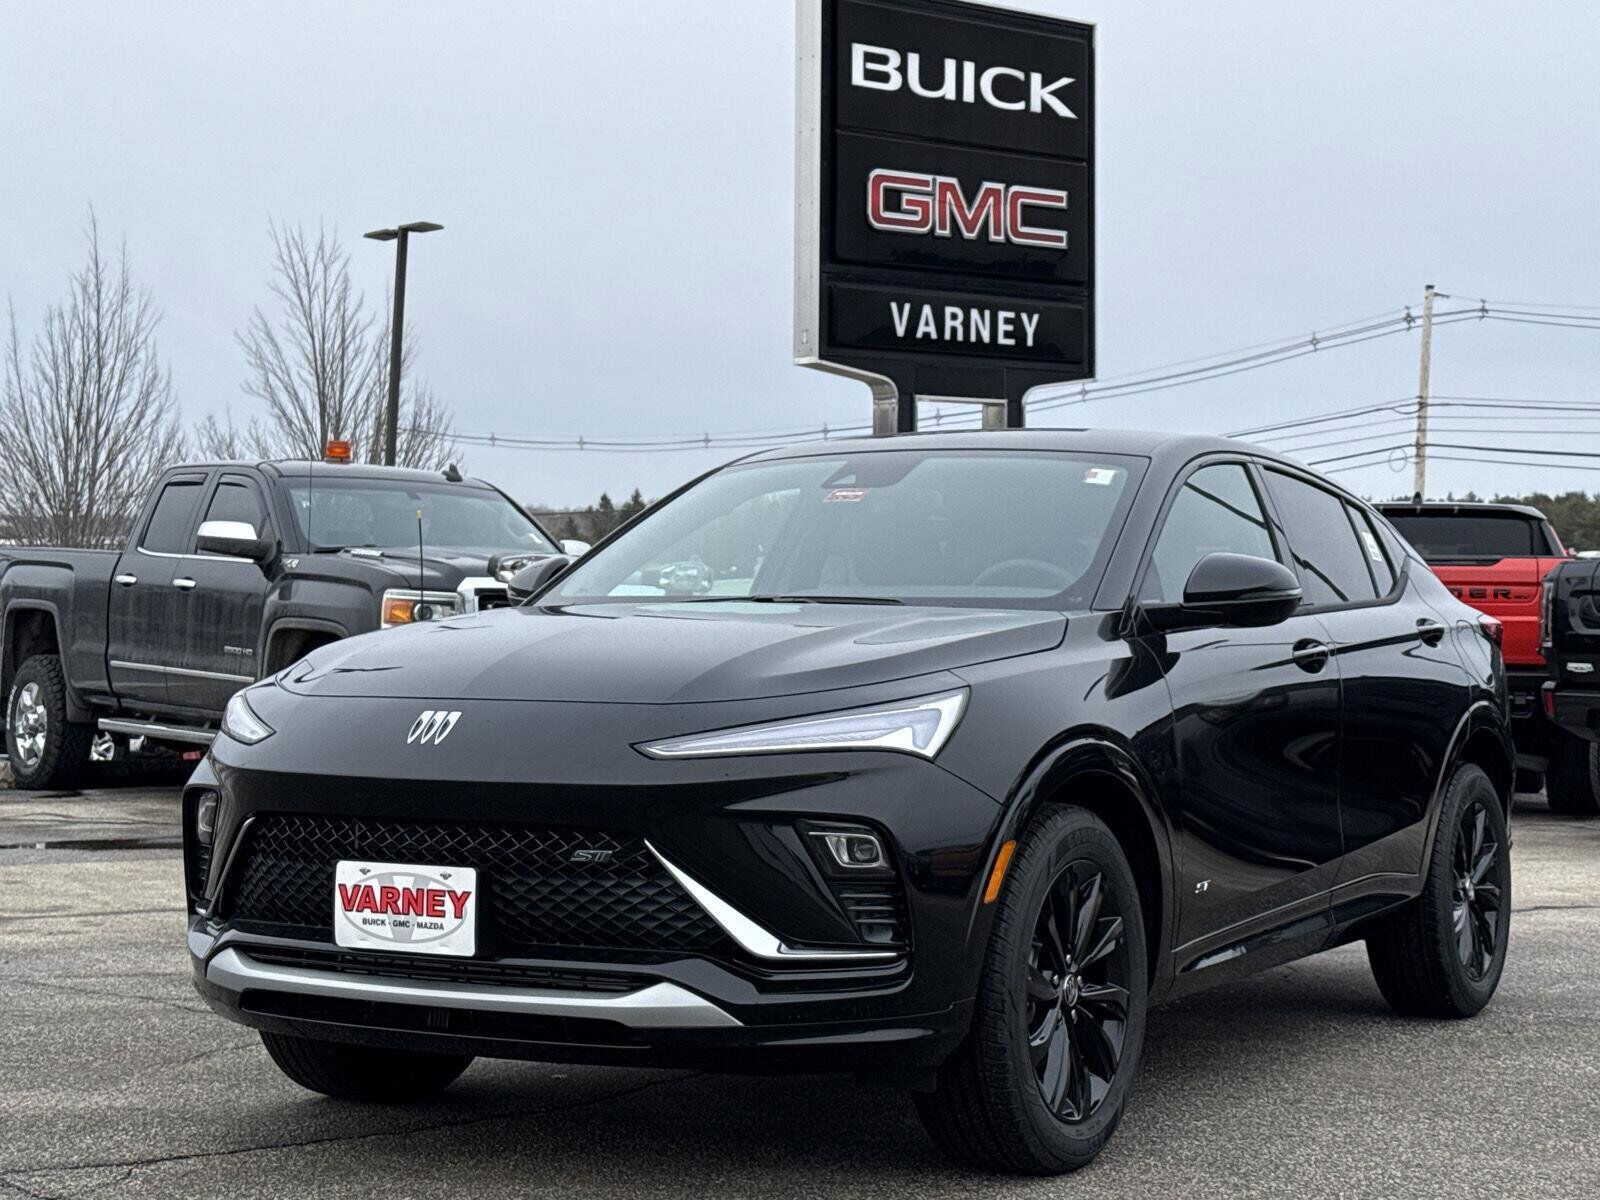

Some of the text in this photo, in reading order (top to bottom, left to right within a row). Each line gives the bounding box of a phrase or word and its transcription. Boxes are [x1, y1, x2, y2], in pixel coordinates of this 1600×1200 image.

[851, 42, 1079, 119] BUICK
[867, 168, 1069, 249] GMC
[890, 301, 1040, 347] VARNEY
[337, 883, 472, 919] VARNEY
[362, 917, 445, 931] BUICK GMC MAZDA
